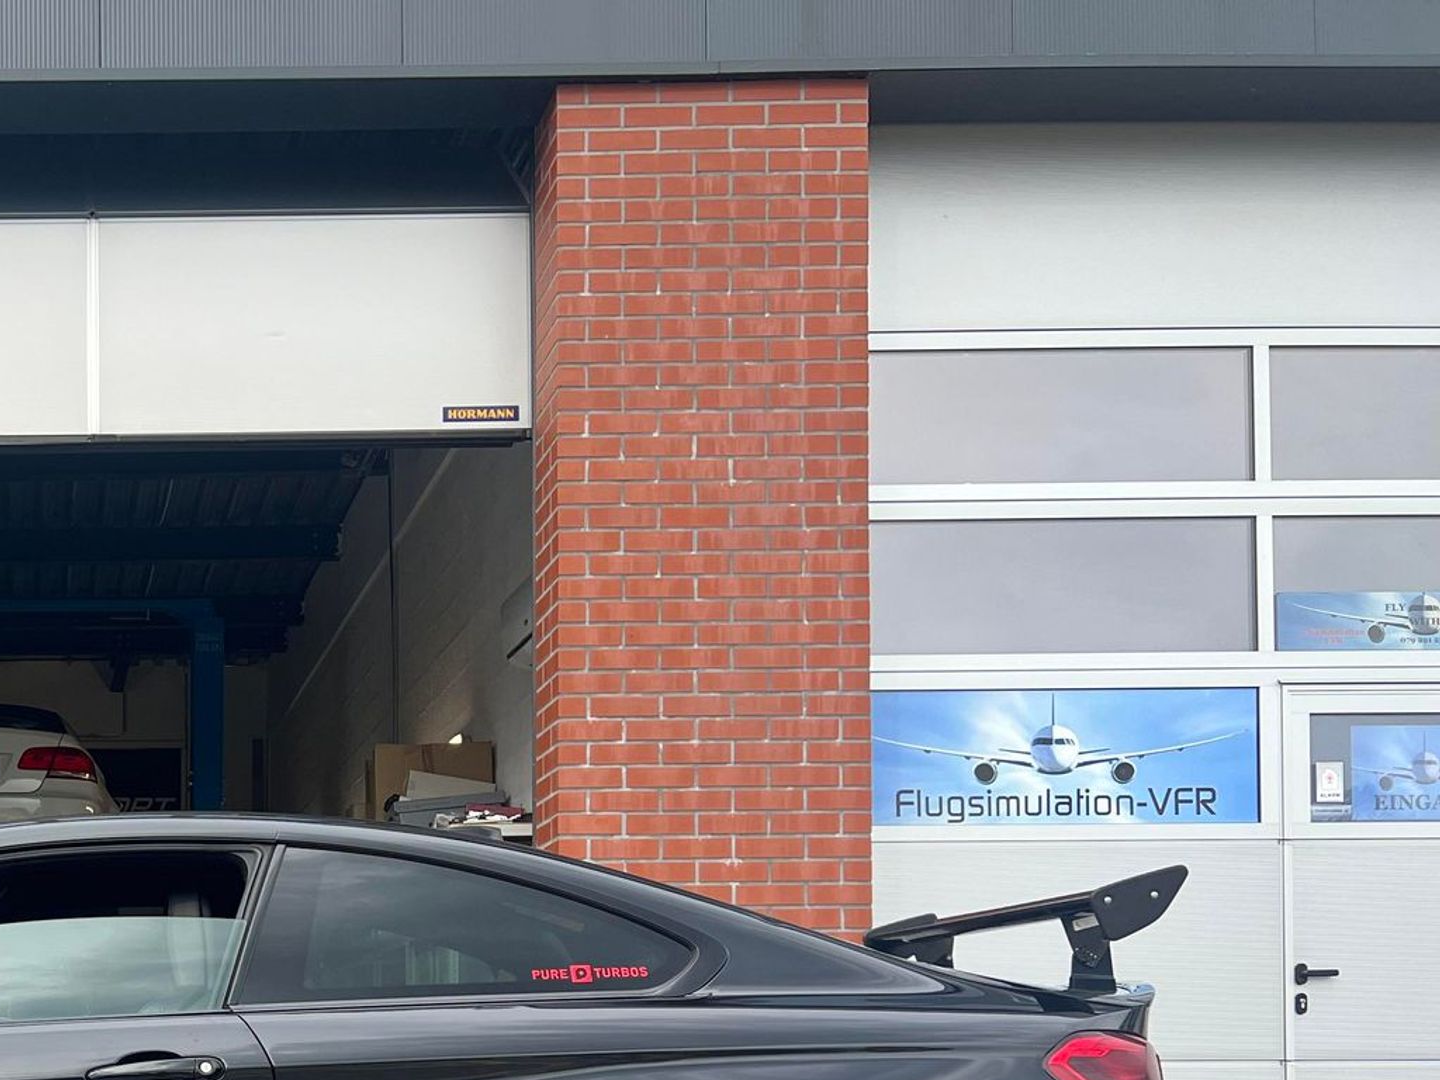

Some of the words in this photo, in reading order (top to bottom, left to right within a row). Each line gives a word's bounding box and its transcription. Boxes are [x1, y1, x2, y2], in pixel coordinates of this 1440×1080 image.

[1384, 603, 1406, 611] FLY
[895, 788, 1217, 823] Flugsimulation-VFR
[531, 969, 569, 980] PURE
[594, 966, 649, 979] TURBOS
